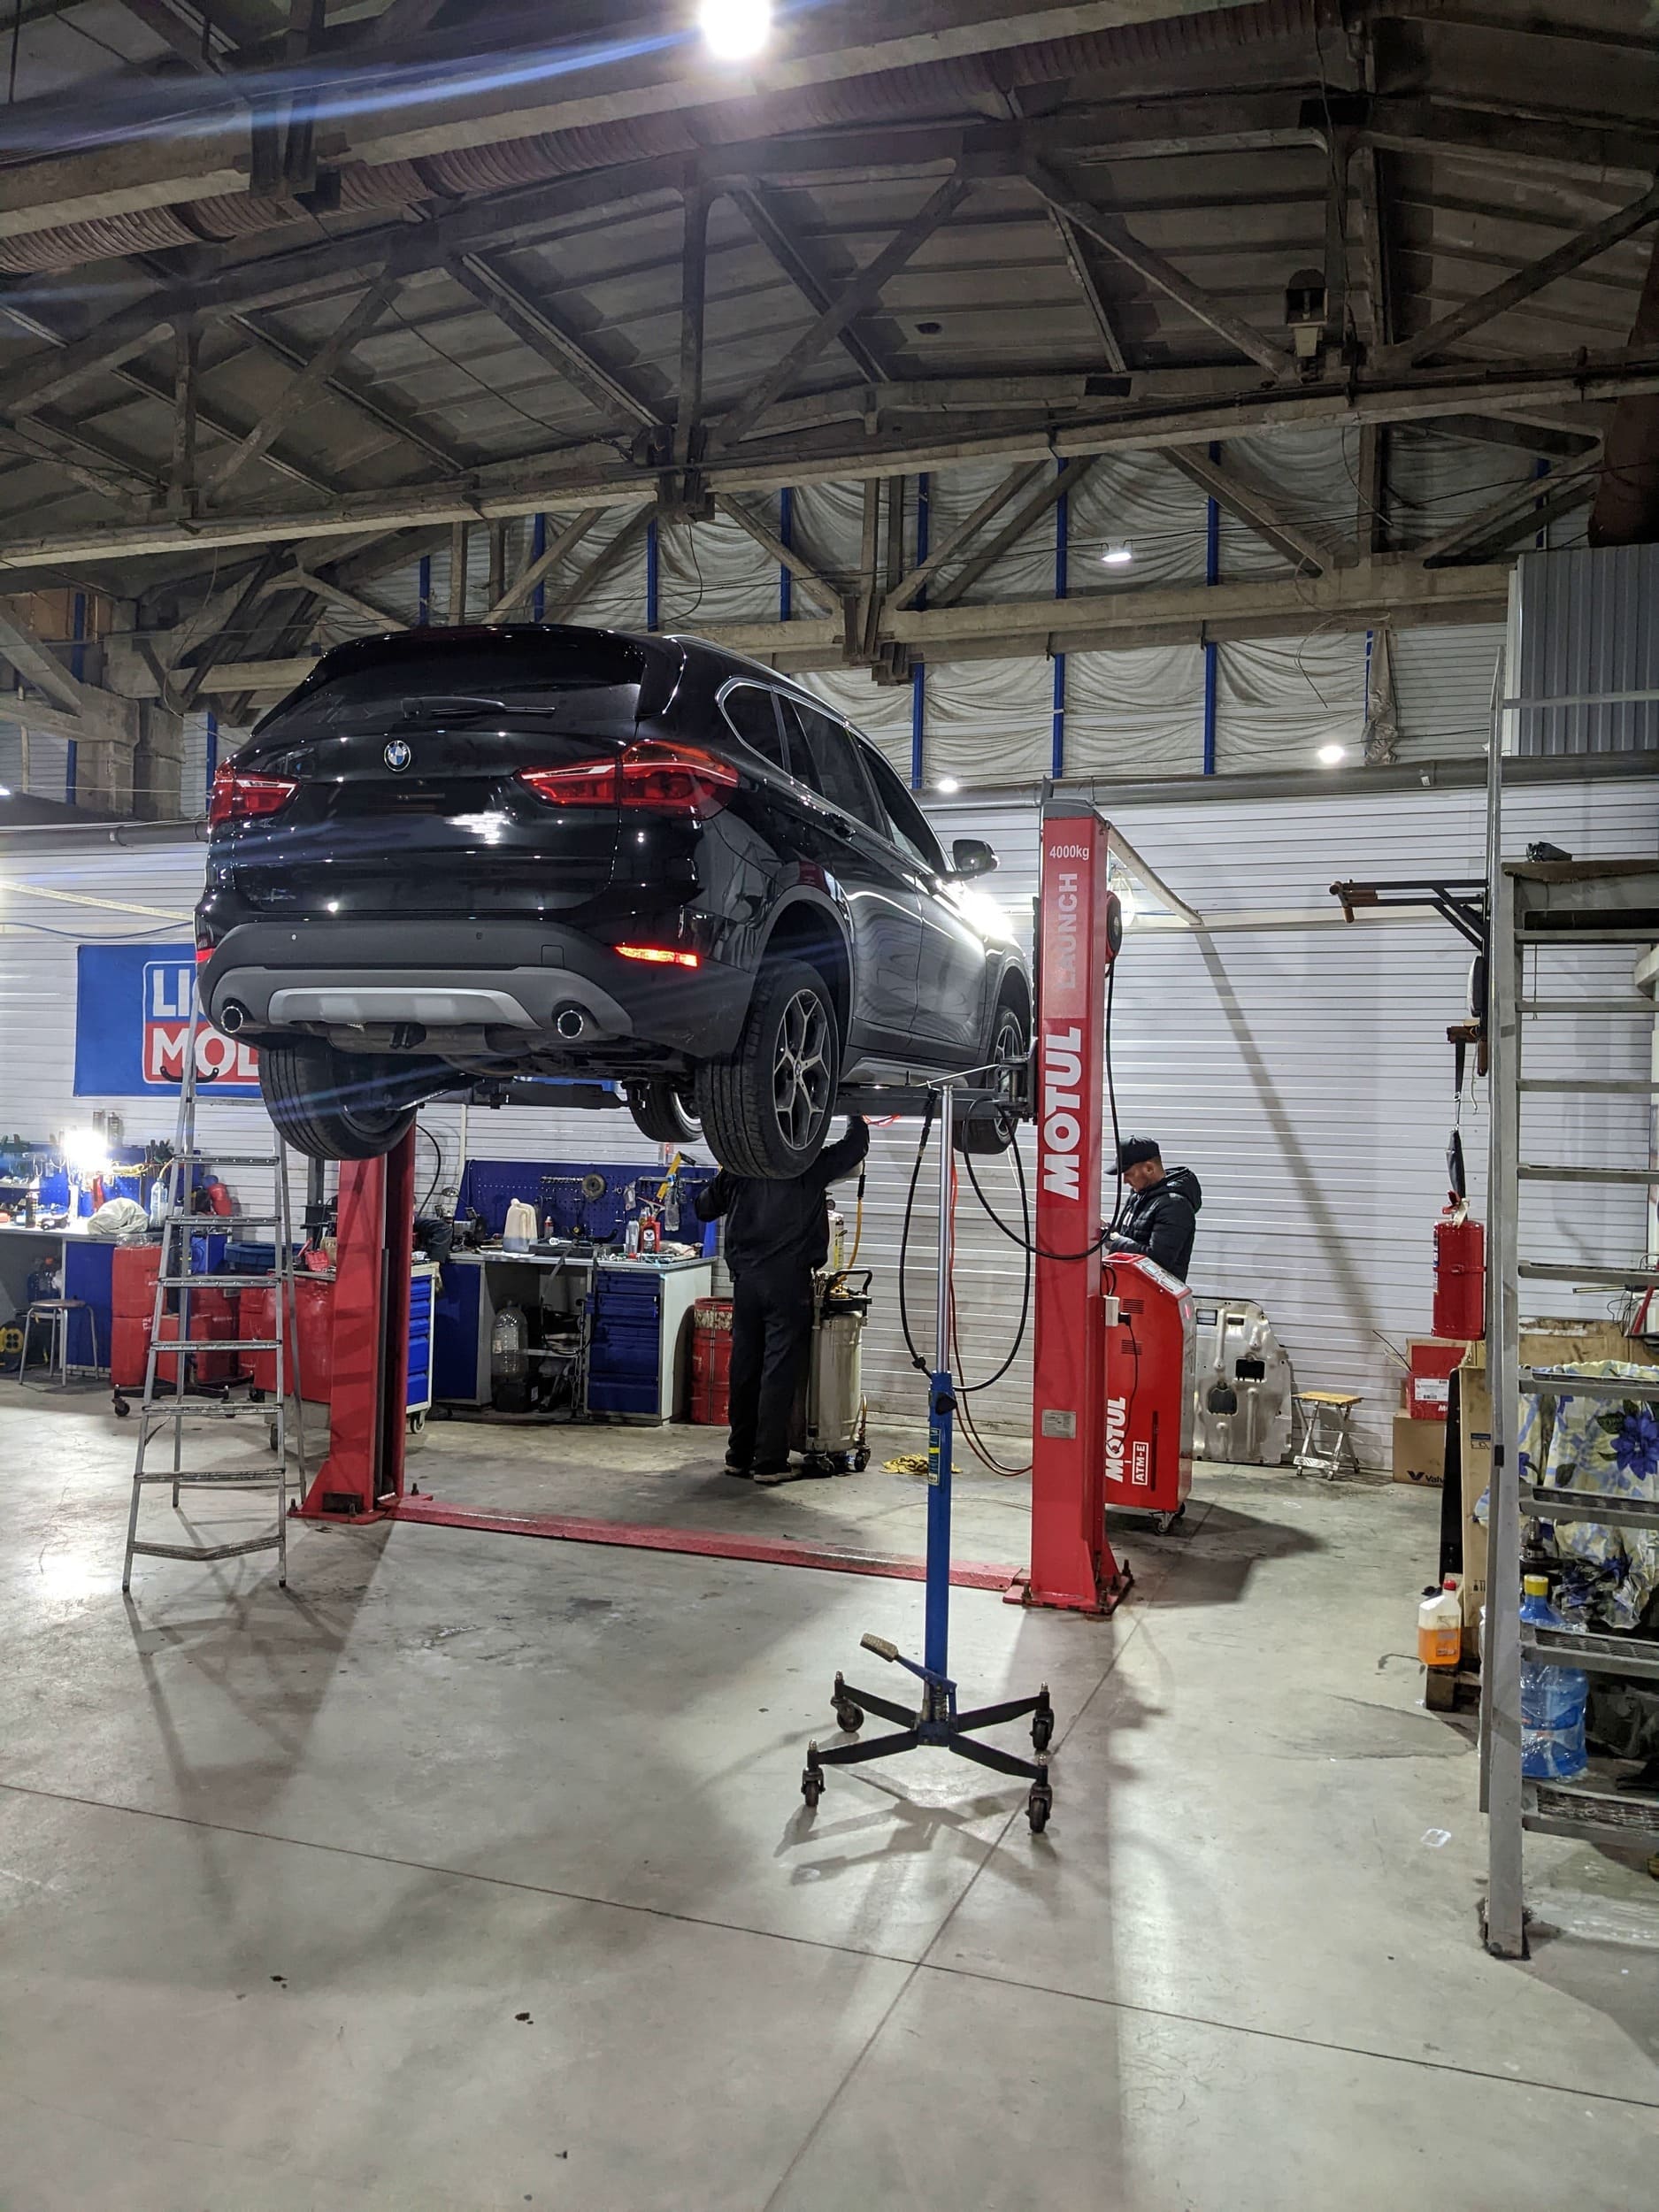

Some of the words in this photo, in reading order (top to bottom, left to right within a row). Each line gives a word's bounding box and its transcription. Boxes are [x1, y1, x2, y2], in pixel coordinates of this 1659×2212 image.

[1049, 845, 1090, 861] 4000kg
[1056, 872, 1078, 990] LAUNCH
[1043, 1026, 1082, 1202] MOTUL
[1105, 1396, 1126, 1484] MOTUL
[1135, 1444, 1146, 1482] ATM-E
